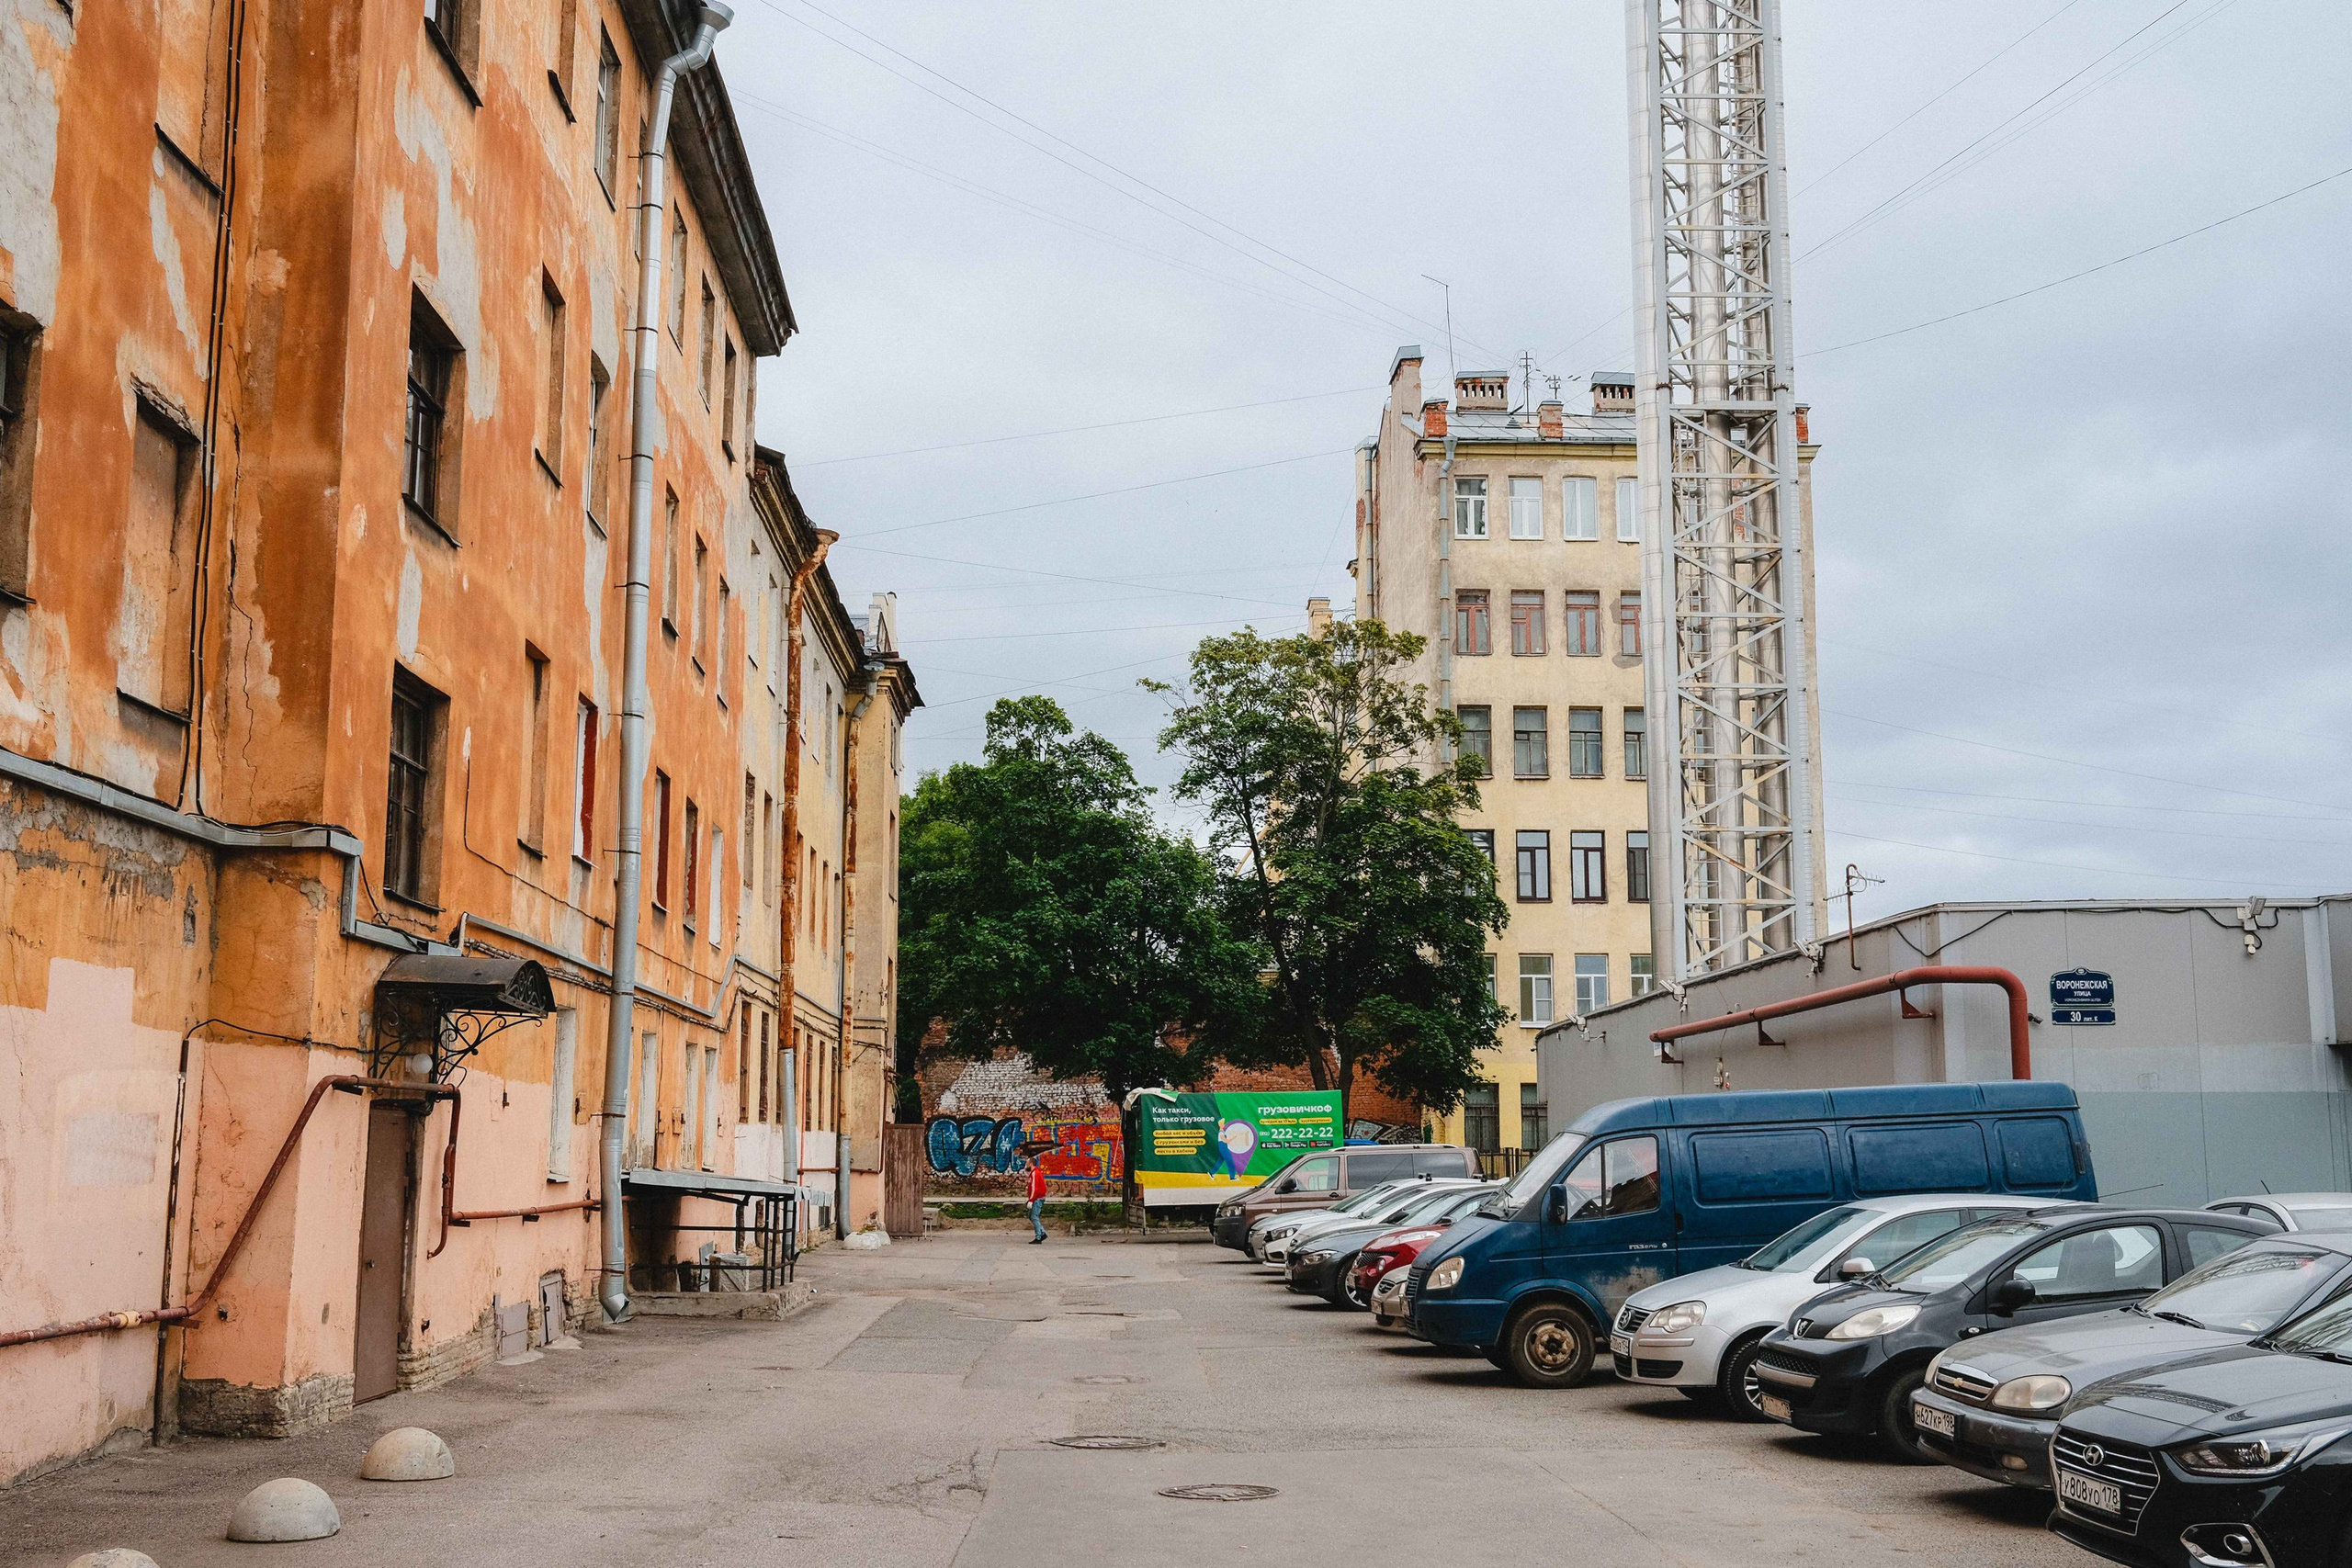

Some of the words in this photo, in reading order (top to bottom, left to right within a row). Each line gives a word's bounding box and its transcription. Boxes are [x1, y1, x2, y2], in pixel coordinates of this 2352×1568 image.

[2055, 980, 2108, 989] ВОРОНЕЖСКАЯ
[2070, 1011, 2082, 1021] 30
[1258, 1104, 1332, 1115] грузовичкоф
[1271, 1126, 1333, 1139] 222-22-22
[2101, 1485, 2118, 1506] 178
